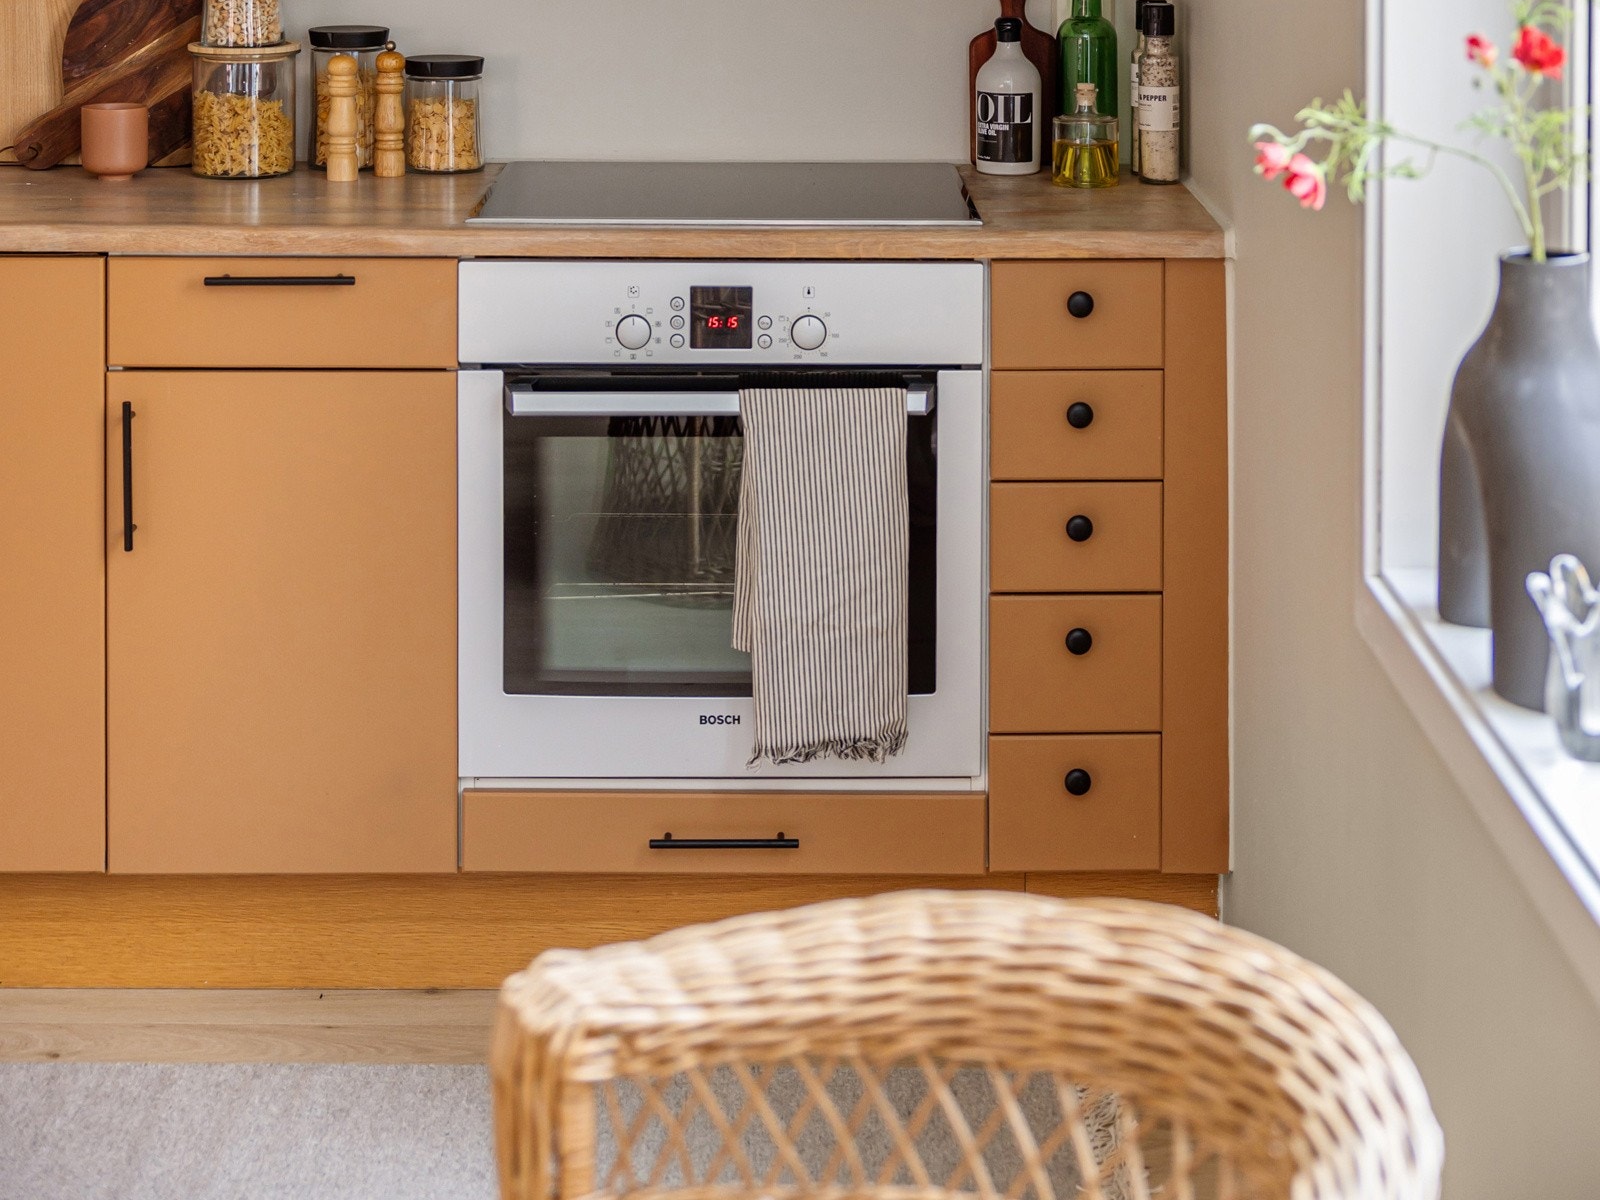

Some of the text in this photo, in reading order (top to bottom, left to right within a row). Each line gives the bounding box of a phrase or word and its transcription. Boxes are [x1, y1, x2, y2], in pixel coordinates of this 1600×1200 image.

[978, 93, 1031, 123] OIL
[708, 317, 738, 328] 15:15
[700, 715, 740, 724] BOSCH
